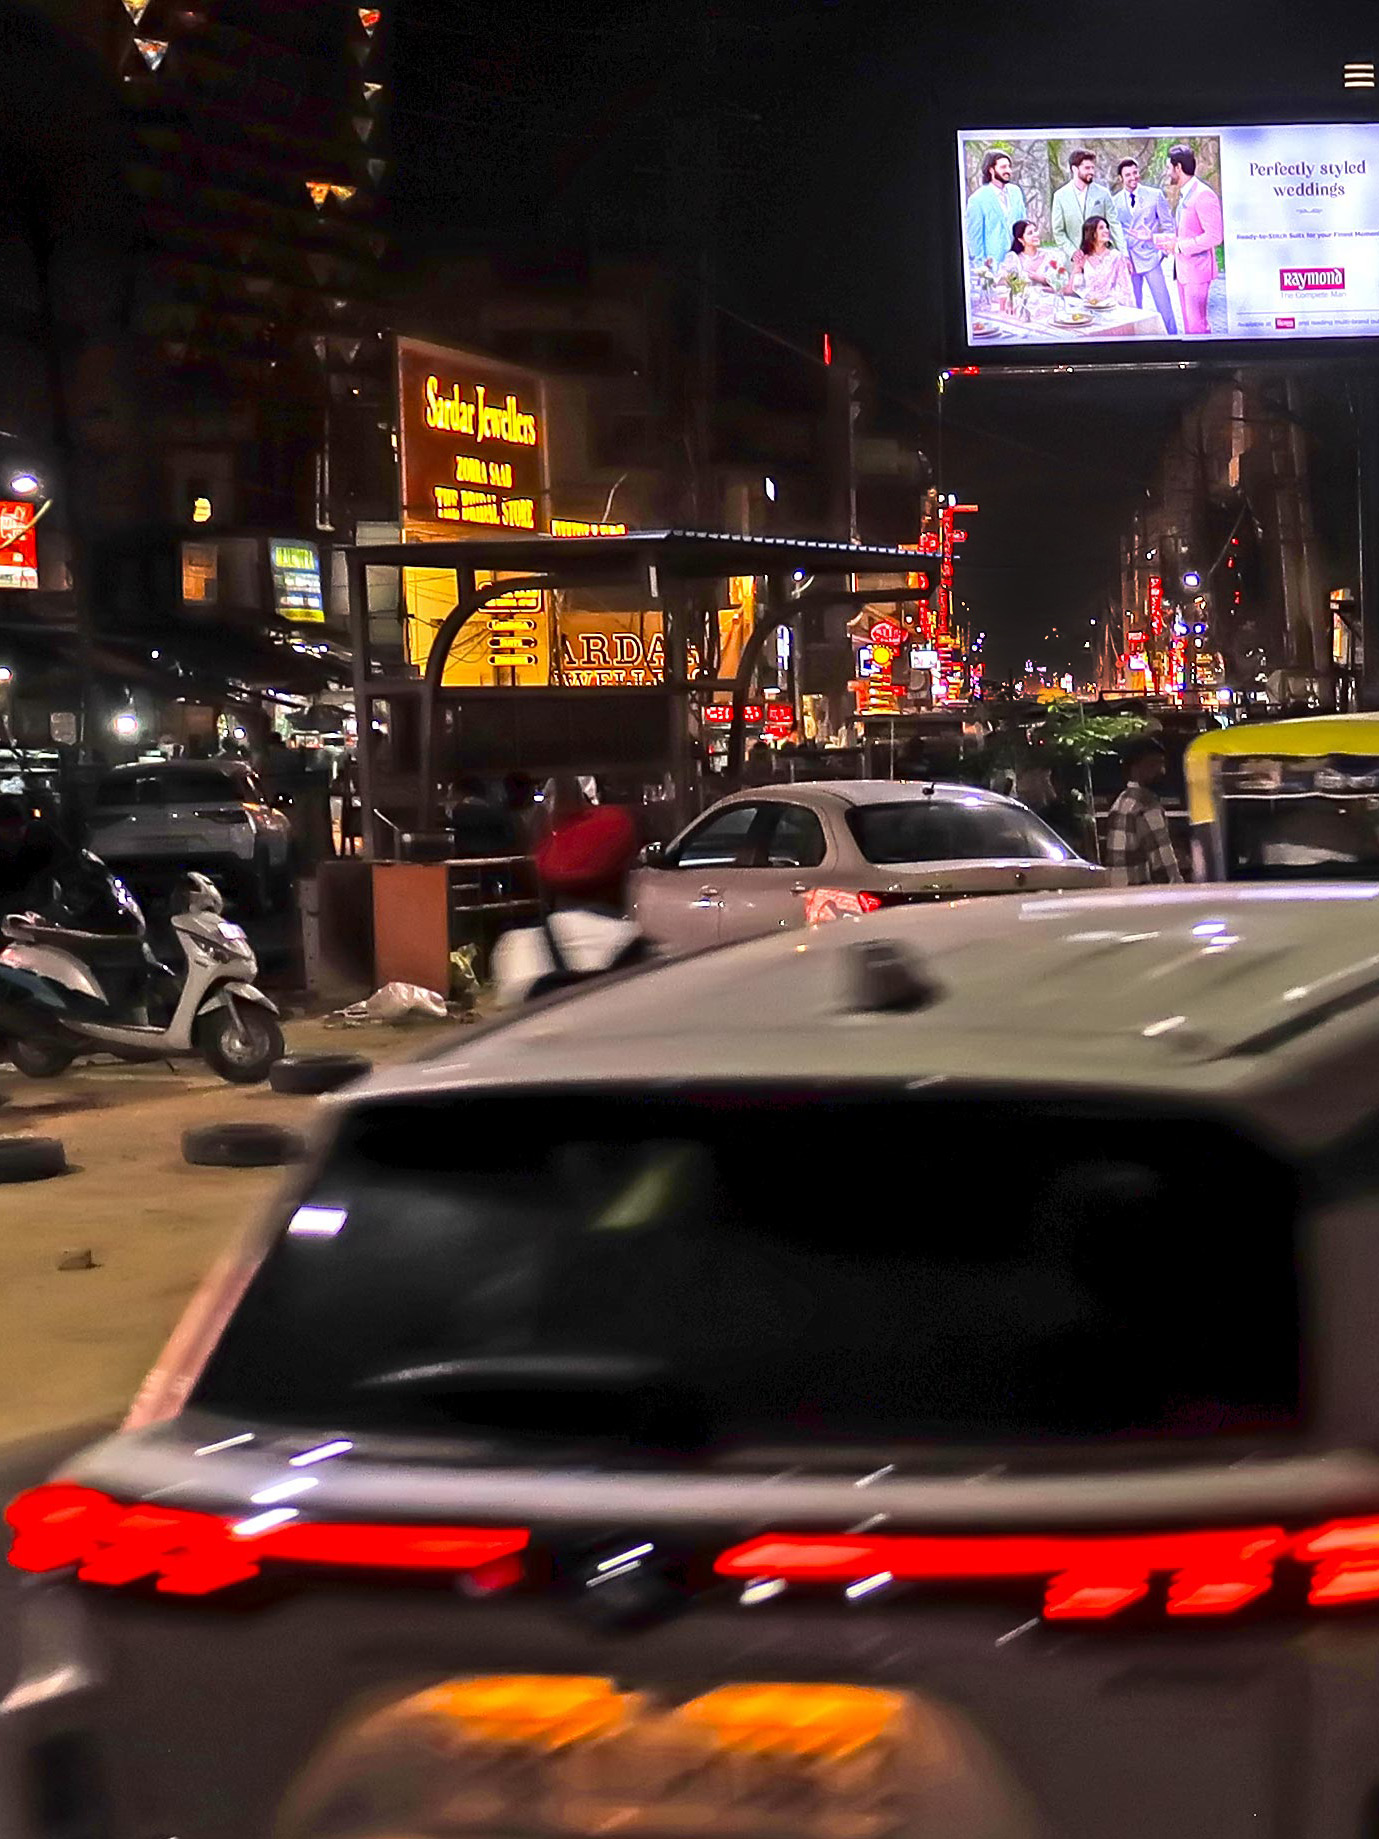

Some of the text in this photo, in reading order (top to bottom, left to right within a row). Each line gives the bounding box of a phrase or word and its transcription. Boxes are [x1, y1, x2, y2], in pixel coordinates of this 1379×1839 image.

[1250, 160, 1366, 178] Perfectly styled
[1273, 182, 1345, 198] weddings
[1283, 269, 1343, 291] Raymond
[426, 375, 536, 445] Sardar Jewellers
[434, 486, 460, 520] THE
[460, 489, 500, 525] BRIDAL
[501, 496, 535, 529] STORE
